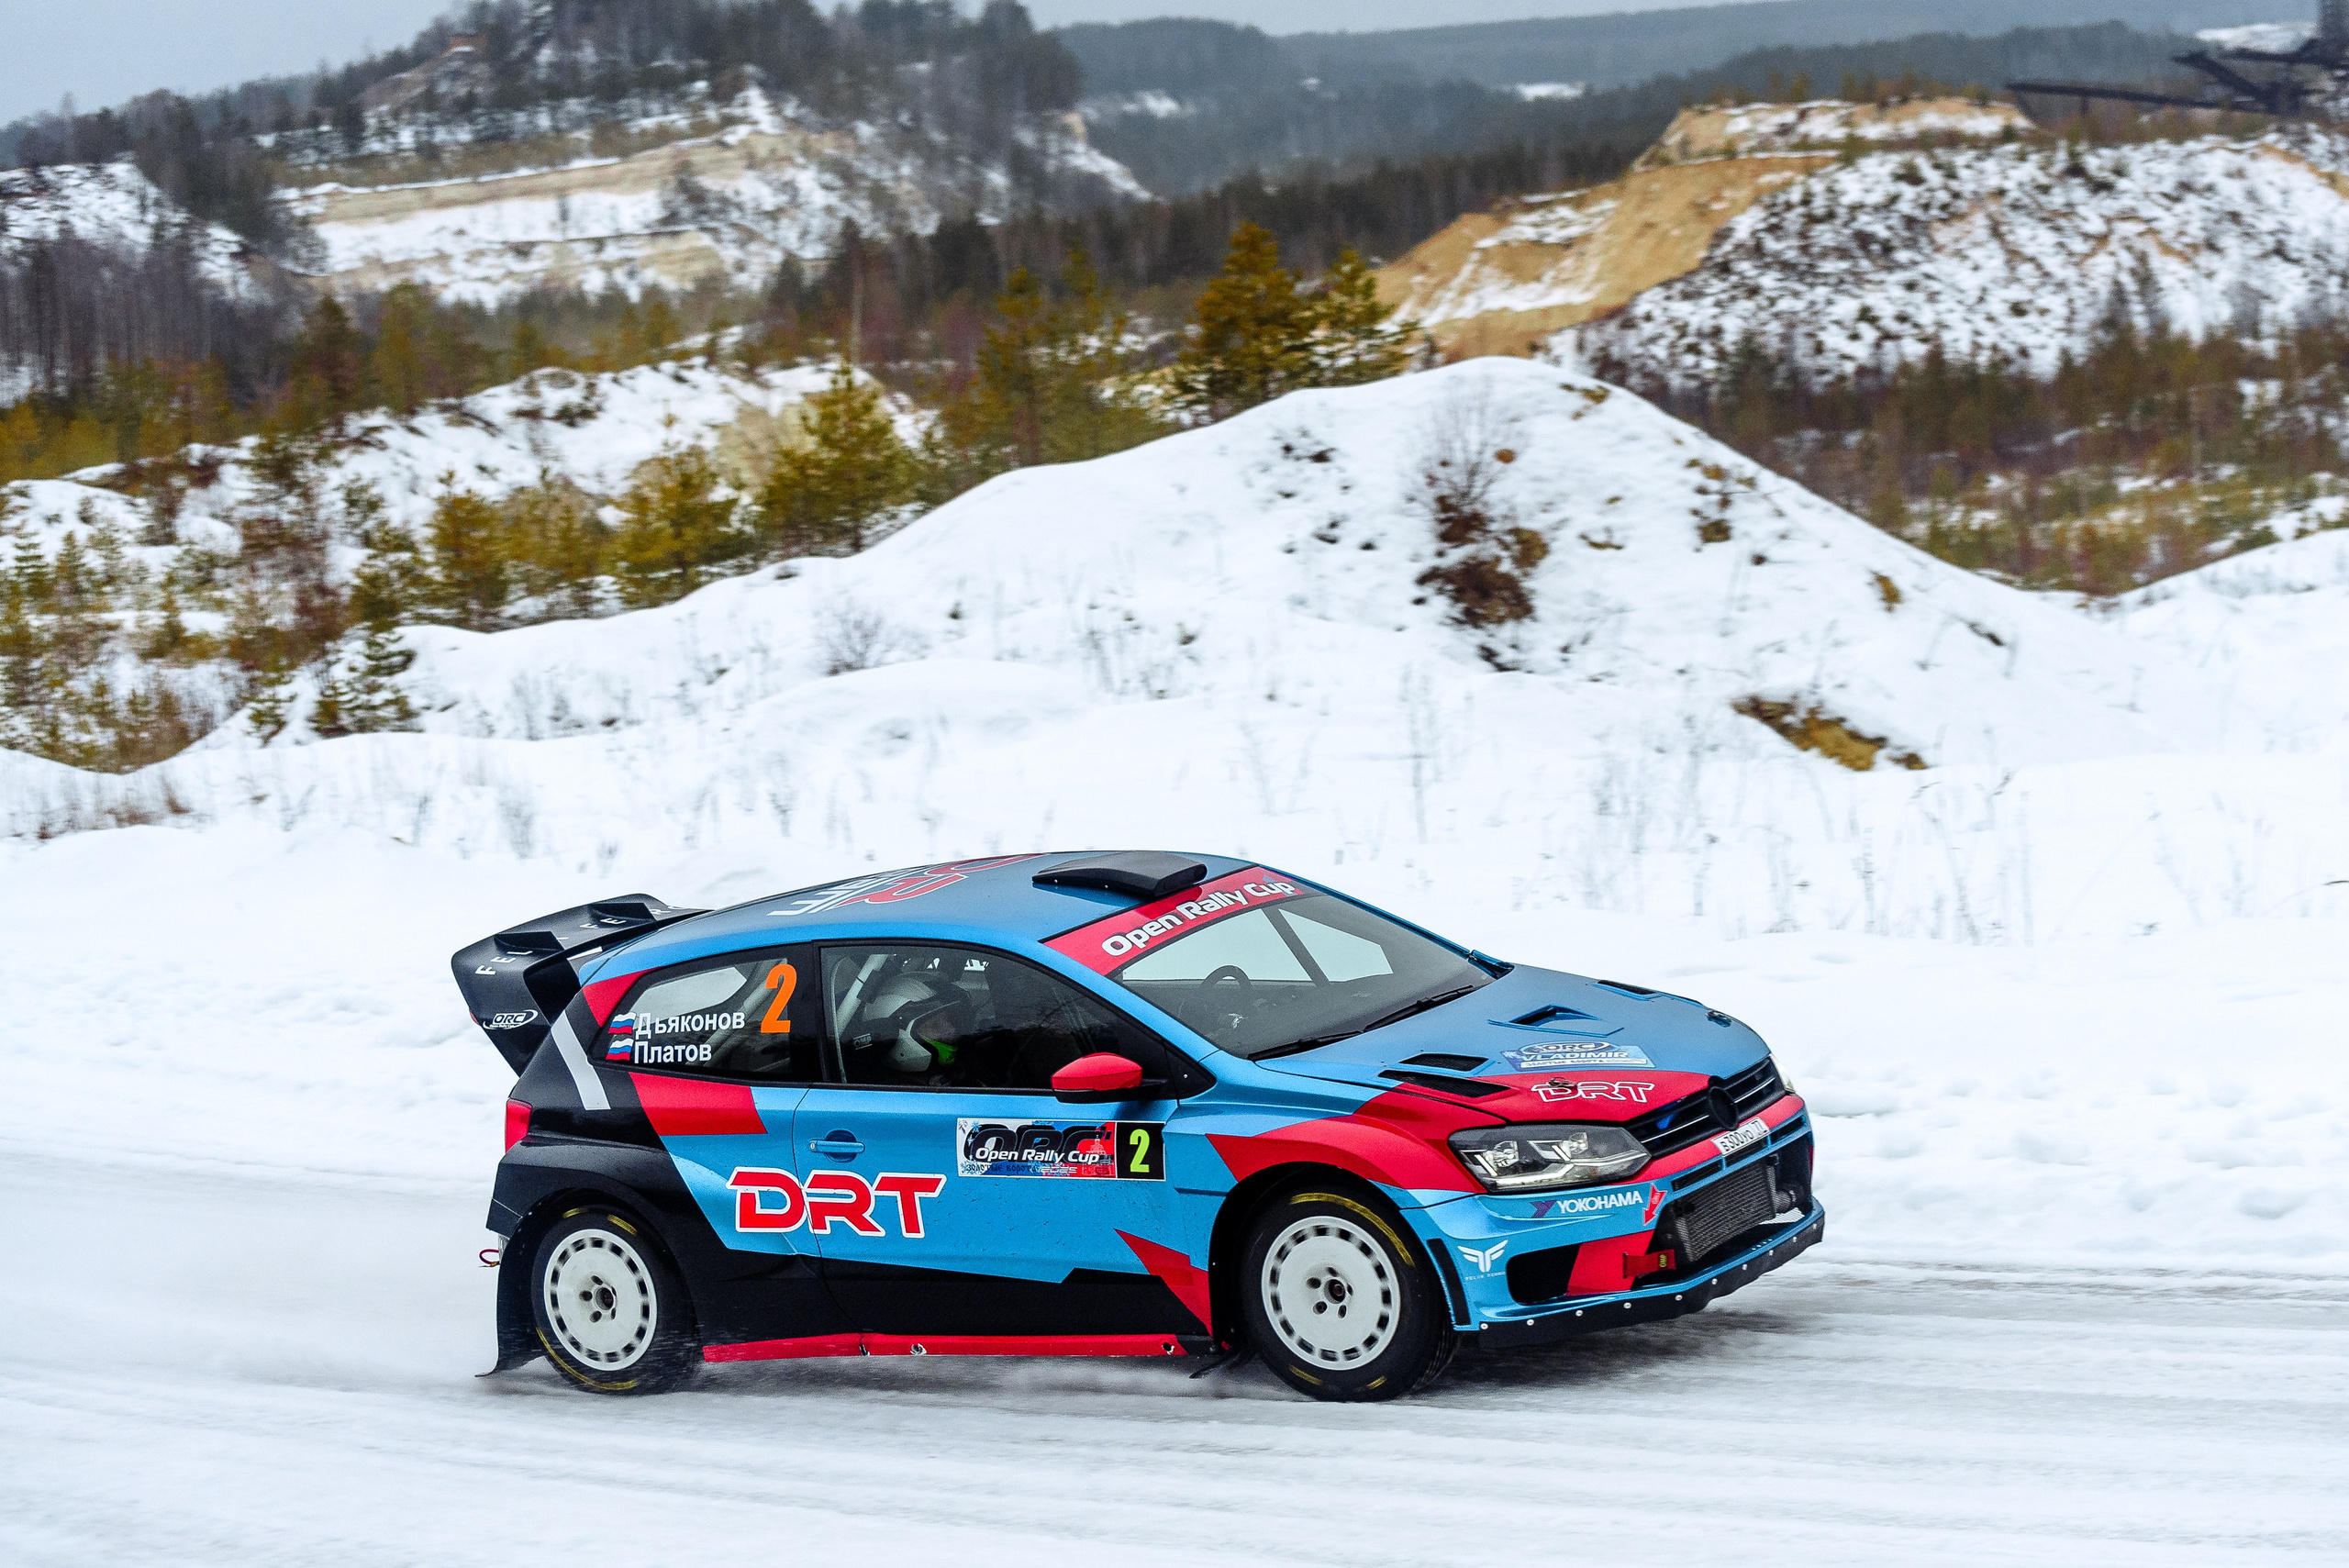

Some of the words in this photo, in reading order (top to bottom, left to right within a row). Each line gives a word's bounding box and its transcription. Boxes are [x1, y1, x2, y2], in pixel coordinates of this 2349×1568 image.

[1101, 914, 1184, 956] Open
[1175, 890, 1249, 920] Rally
[1243, 881, 1297, 897] Cup
[760, 963, 797, 1034] 2
[494, 1014, 525, 1024] ORC
[635, 1011, 745, 1040] Дьяконов
[634, 1040, 712, 1064] Платов
[1522, 1051, 1629, 1062] VLADIMIR
[1543, 1043, 1595, 1051] ORC
[1531, 1081, 1654, 1103] DRT
[975, 1148, 1019, 1162] Open
[1021, 1149, 1064, 1163] Rally
[1067, 1150, 1100, 1165] Cup
[1129, 1129, 1151, 1173] 2
[726, 1166, 947, 1239] DRT
[1556, 1190, 1643, 1214] YOKOHAMA
